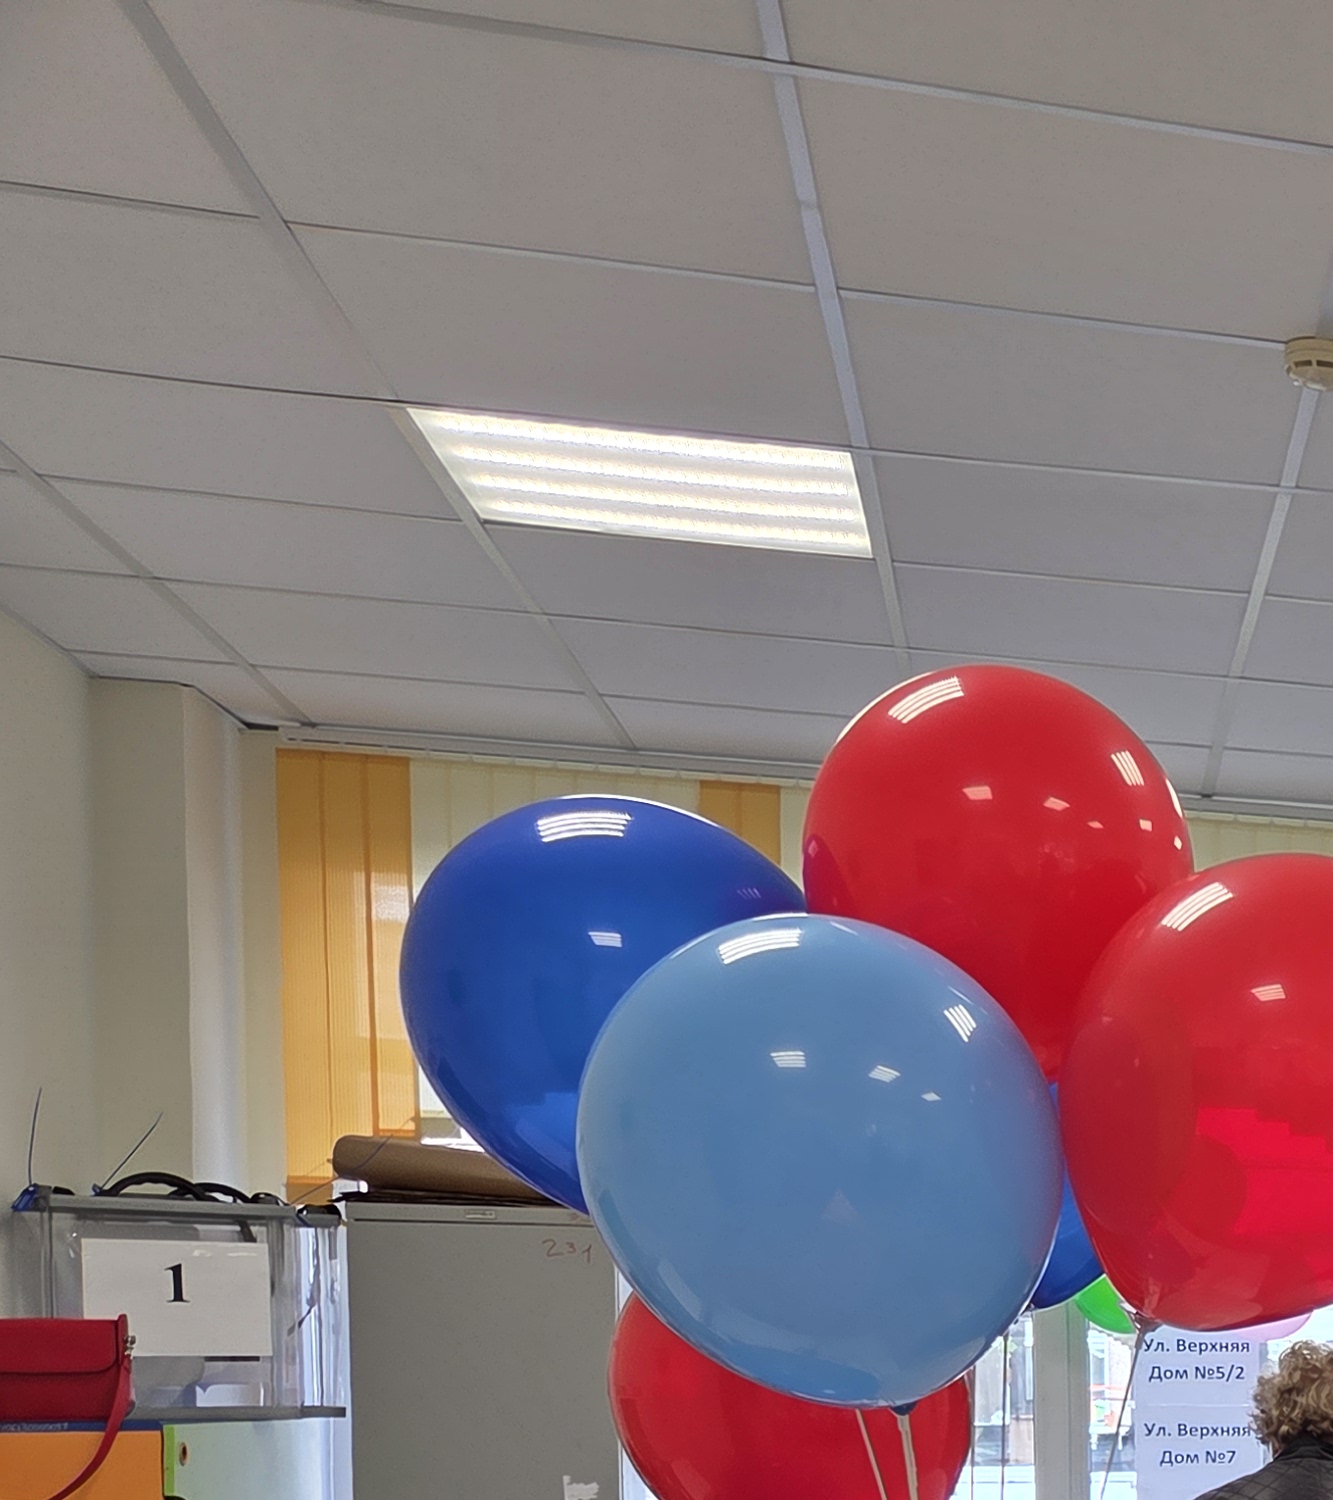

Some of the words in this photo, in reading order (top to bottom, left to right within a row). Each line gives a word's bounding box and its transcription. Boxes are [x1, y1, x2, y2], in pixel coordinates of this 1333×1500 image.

[164, 1263, 191, 1303] 1
[1143, 1338, 1171, 1353] Ул.
[1176, 1338, 1250, 1356] Верхняя
[1149, 1365, 1189, 1384] Дом
[1194, 1364, 1246, 1383] №5/2
[1143, 1423, 1172, 1438] Ул.
[1177, 1423, 1251, 1440] Верхняя
[1159, 1450, 1200, 1467] Дом
[1204, 1450, 1237, 1465] №7
